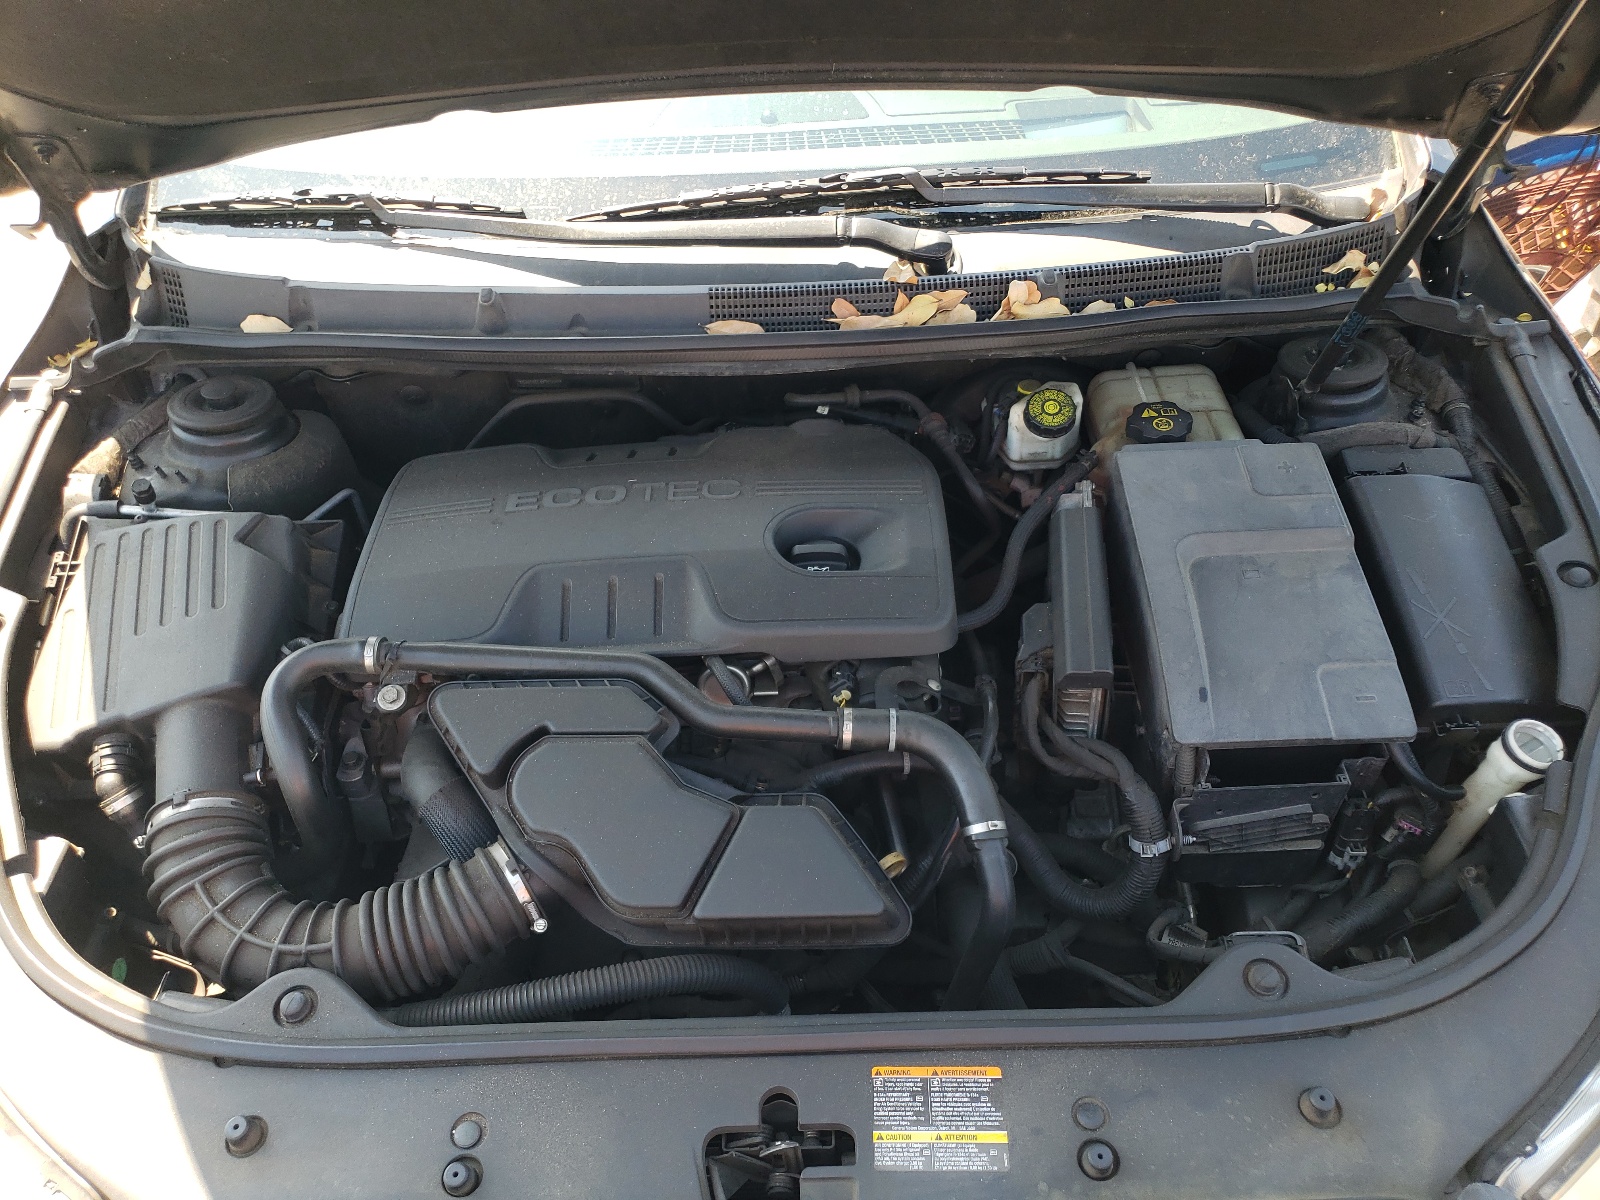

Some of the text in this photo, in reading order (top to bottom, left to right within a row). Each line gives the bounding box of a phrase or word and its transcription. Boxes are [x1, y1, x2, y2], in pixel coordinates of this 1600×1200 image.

[504, 479, 742, 513] ECOTEC
[885, 1133, 912, 1141] CAUTION
[944, 1133, 978, 1141] ATTENTION
